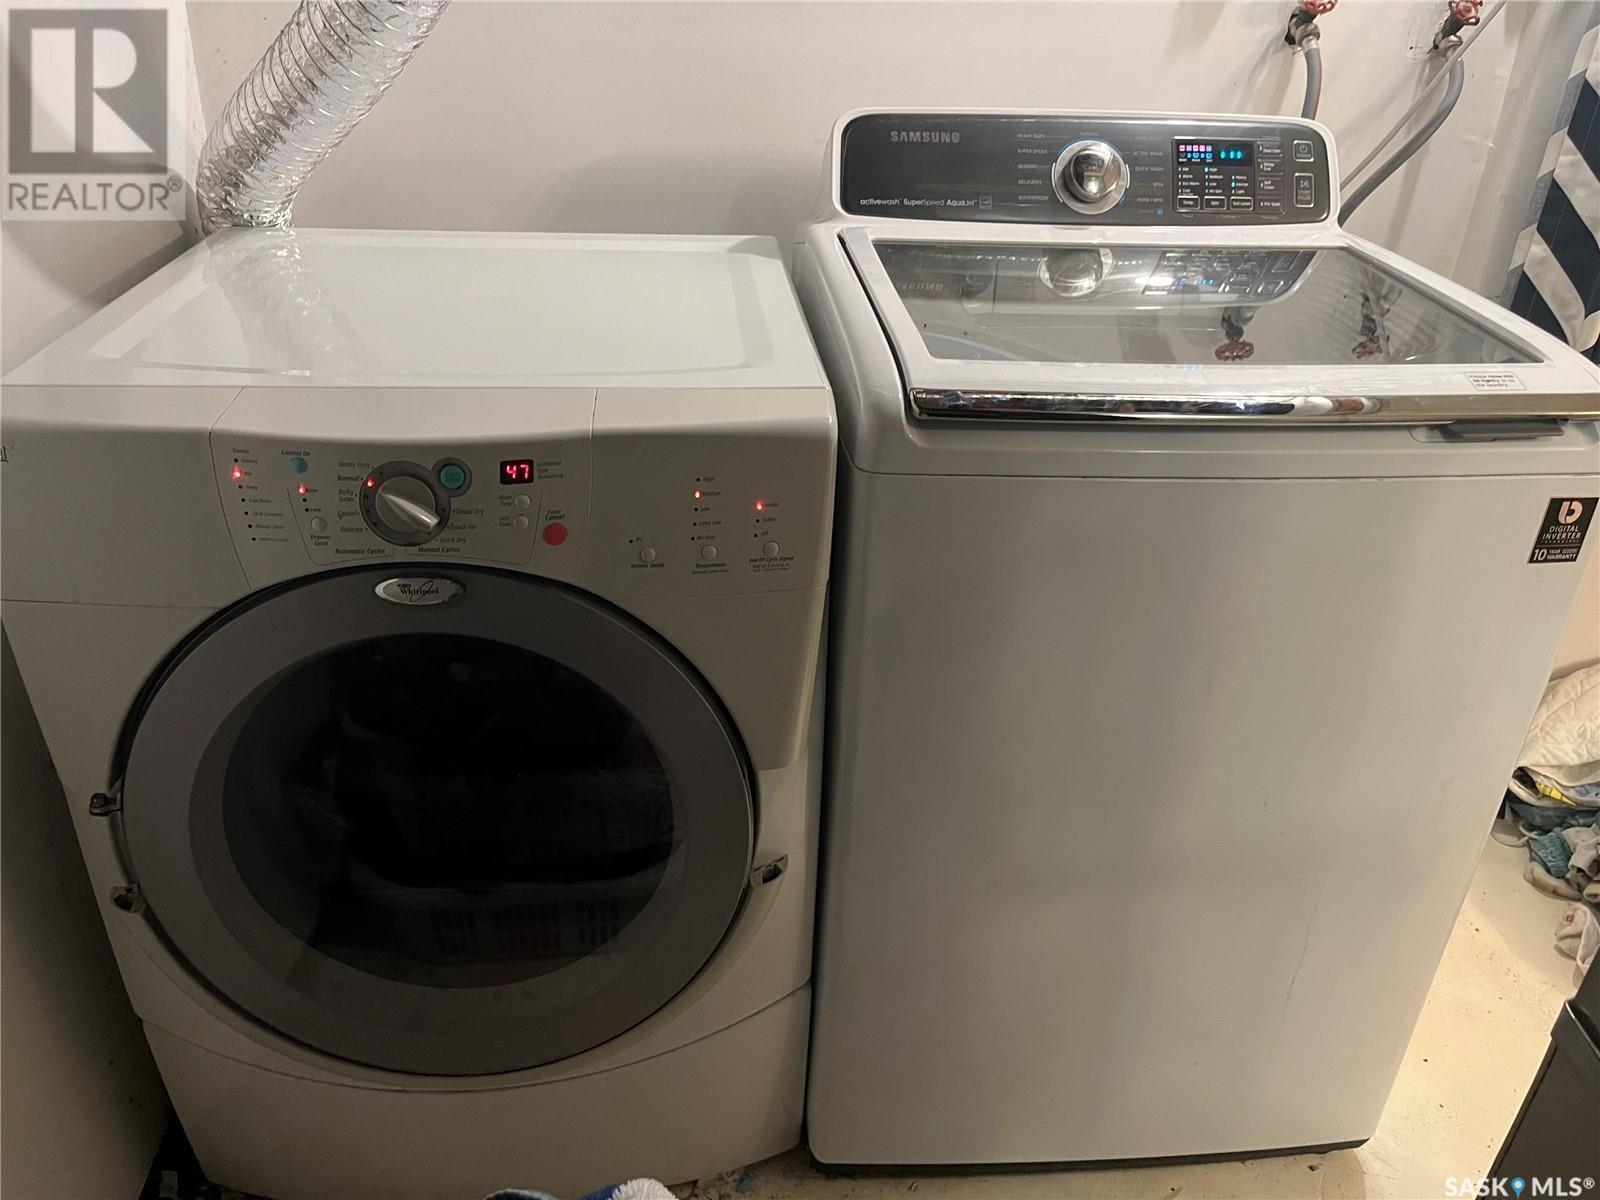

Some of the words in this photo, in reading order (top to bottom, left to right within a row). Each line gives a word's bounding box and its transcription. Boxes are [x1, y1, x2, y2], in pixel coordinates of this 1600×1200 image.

[890, 130, 960, 144] SAMSUNG
[506, 463, 529, 479] 47
[475, 508, 485, 516] Dry
[1549, 525, 1579, 533] DIGITAL
[1542, 532, 1582, 540] INVERTER
[1533, 549, 1548, 561] 10
[401, 583, 439, 598] Whirlpool
